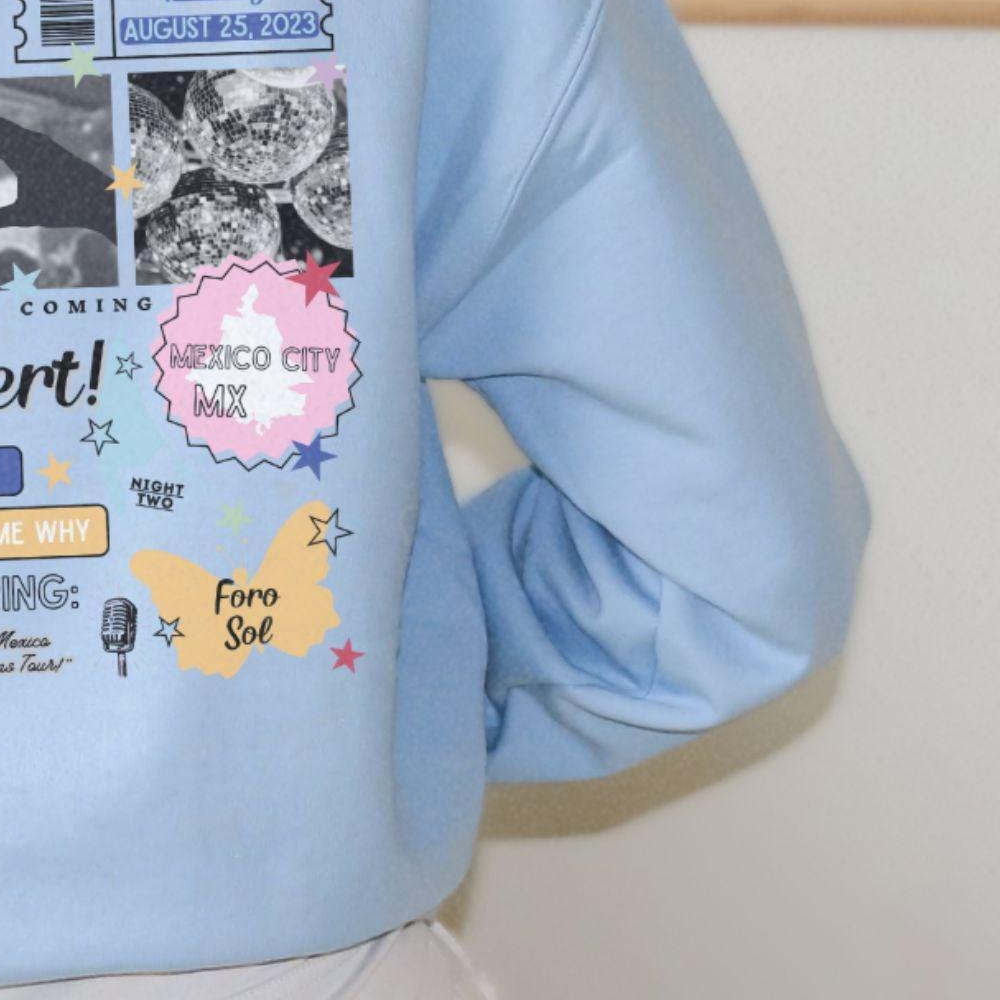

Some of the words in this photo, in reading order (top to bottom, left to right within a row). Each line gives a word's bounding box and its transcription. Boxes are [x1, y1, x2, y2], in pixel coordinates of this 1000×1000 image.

[123, 17, 210, 42] AUGUST
[219, 14, 254, 41] 25,
[261, 11, 317, 37] 2023
[20, 296, 153, 316] COMING
[169, 343, 272, 371] MEXICO
[281, 346, 341, 373] CITY
[193, 384, 248, 419] MX
[130, 477, 185, 498] NIGHT
[137, 493, 174, 511] TWO
[34, 519, 90, 544] WHY
[214, 578, 280, 615] Foro
[224, 615, 274, 651] Sol
